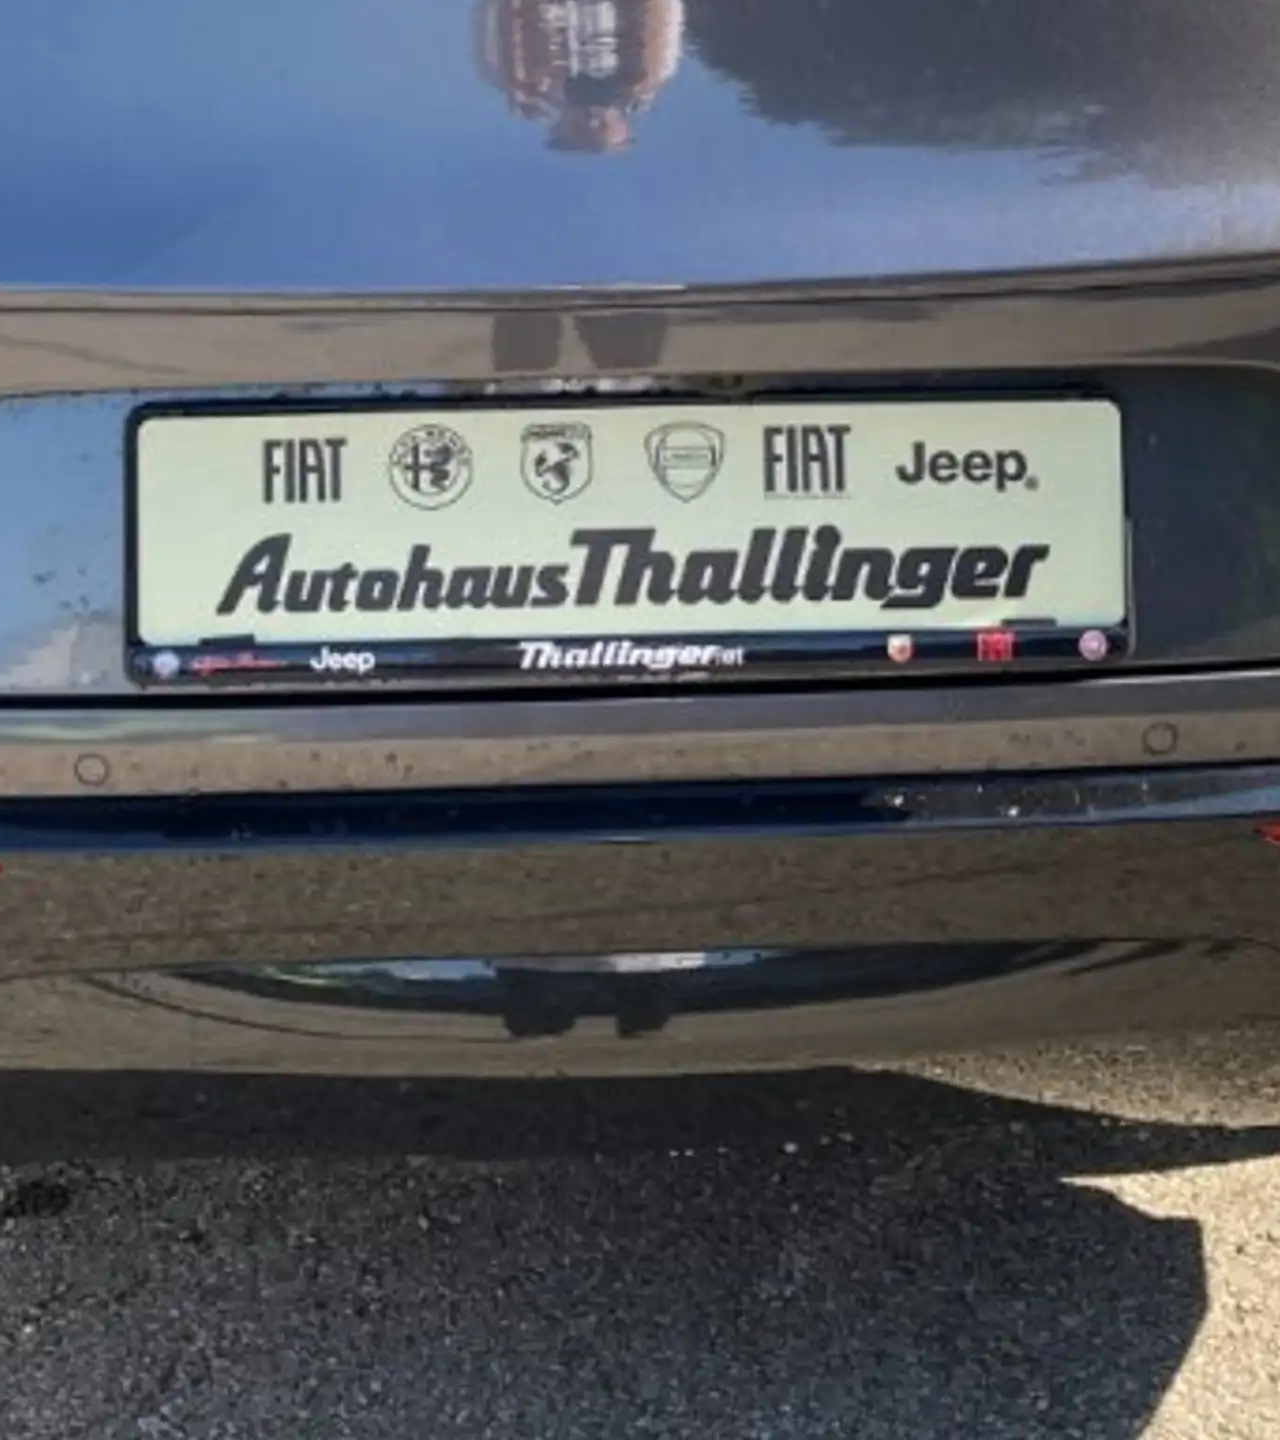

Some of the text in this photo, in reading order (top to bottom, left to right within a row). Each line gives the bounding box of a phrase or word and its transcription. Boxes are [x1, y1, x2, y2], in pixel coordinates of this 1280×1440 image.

[262, 437, 348, 504] FIAT
[763, 425, 852, 493] FIAT
[895, 441, 1029, 492] Jeep
[309, 646, 376, 676] Jeep
